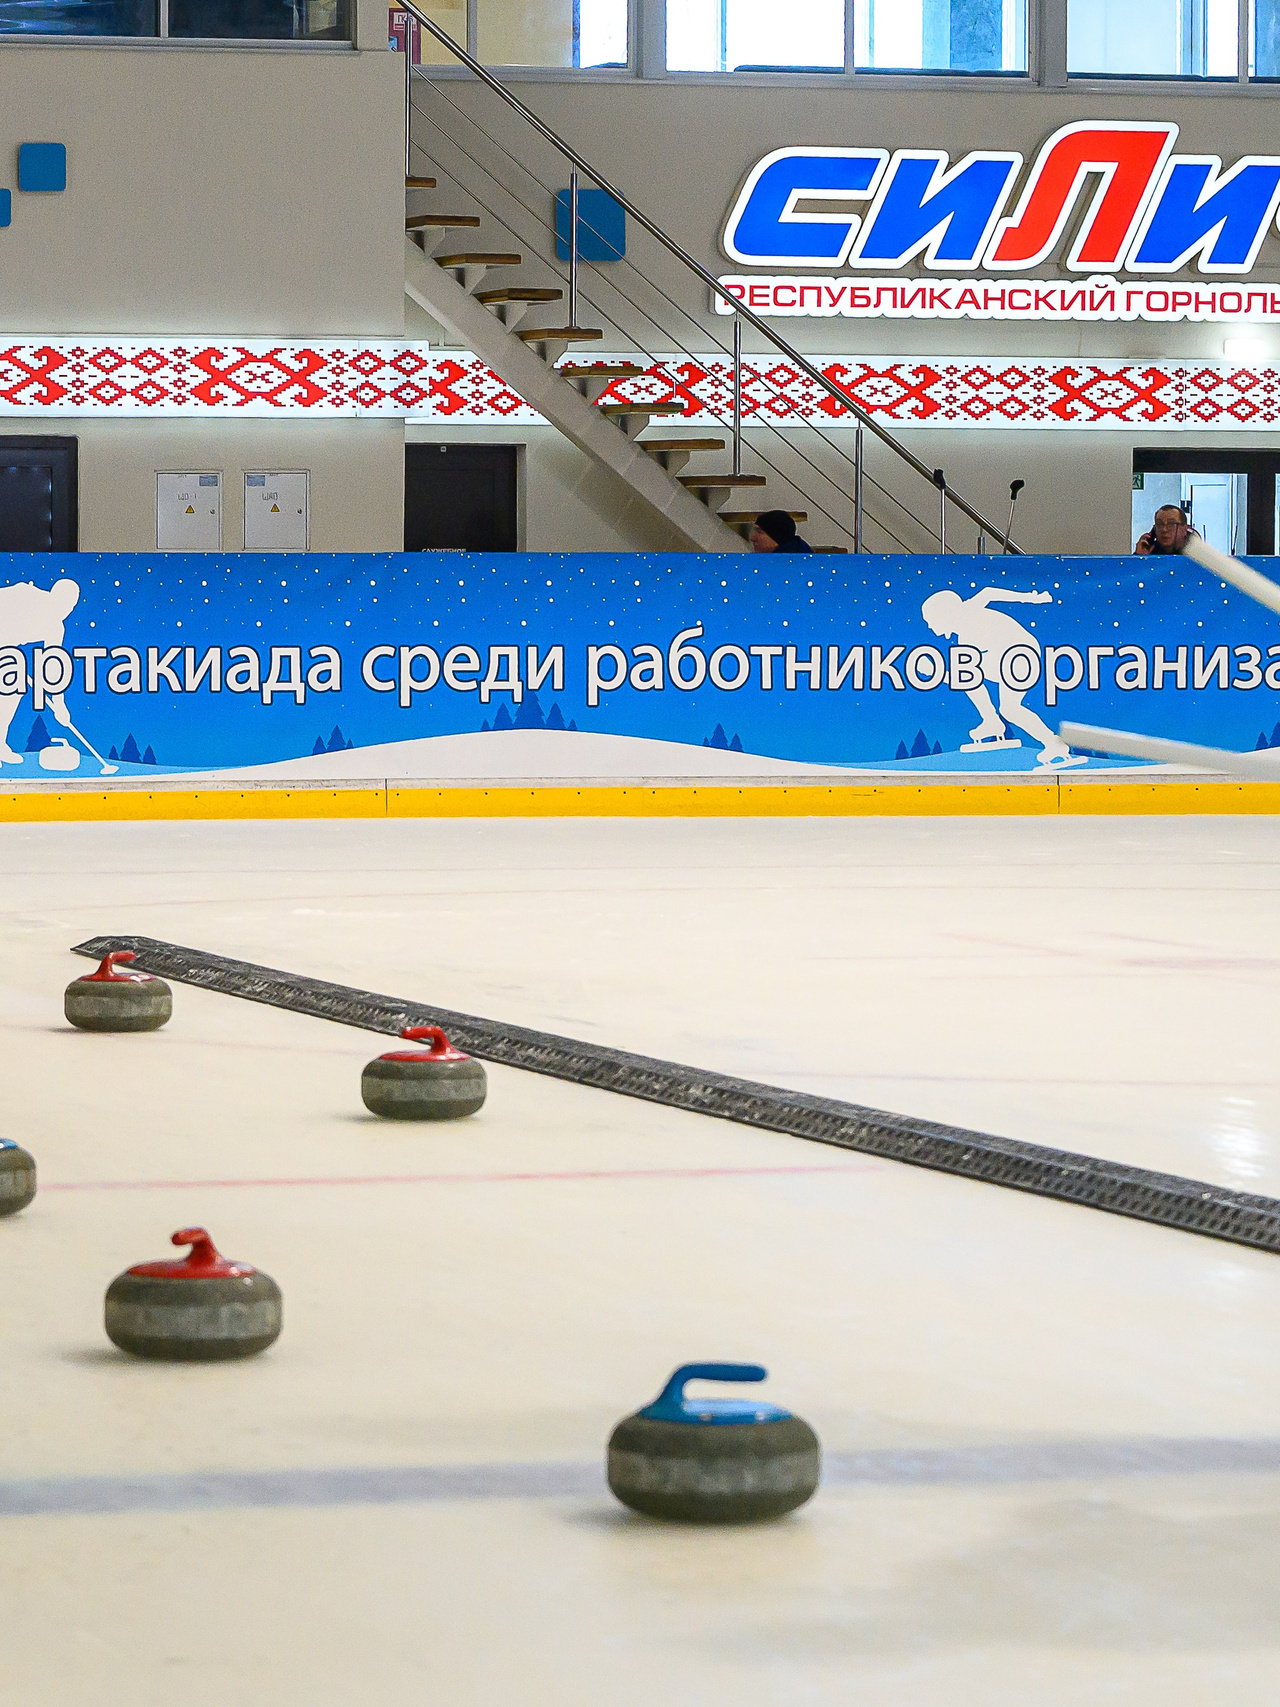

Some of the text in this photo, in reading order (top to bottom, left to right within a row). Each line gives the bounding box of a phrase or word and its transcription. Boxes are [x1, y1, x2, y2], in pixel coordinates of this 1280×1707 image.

[726, 122, 1280, 272] СИЛИ
[724, 284, 1116, 313] РЕСПУБЛИКАНСКИЙ
[361, 643, 564, 706] среди
[587, 626, 985, 706] работников
